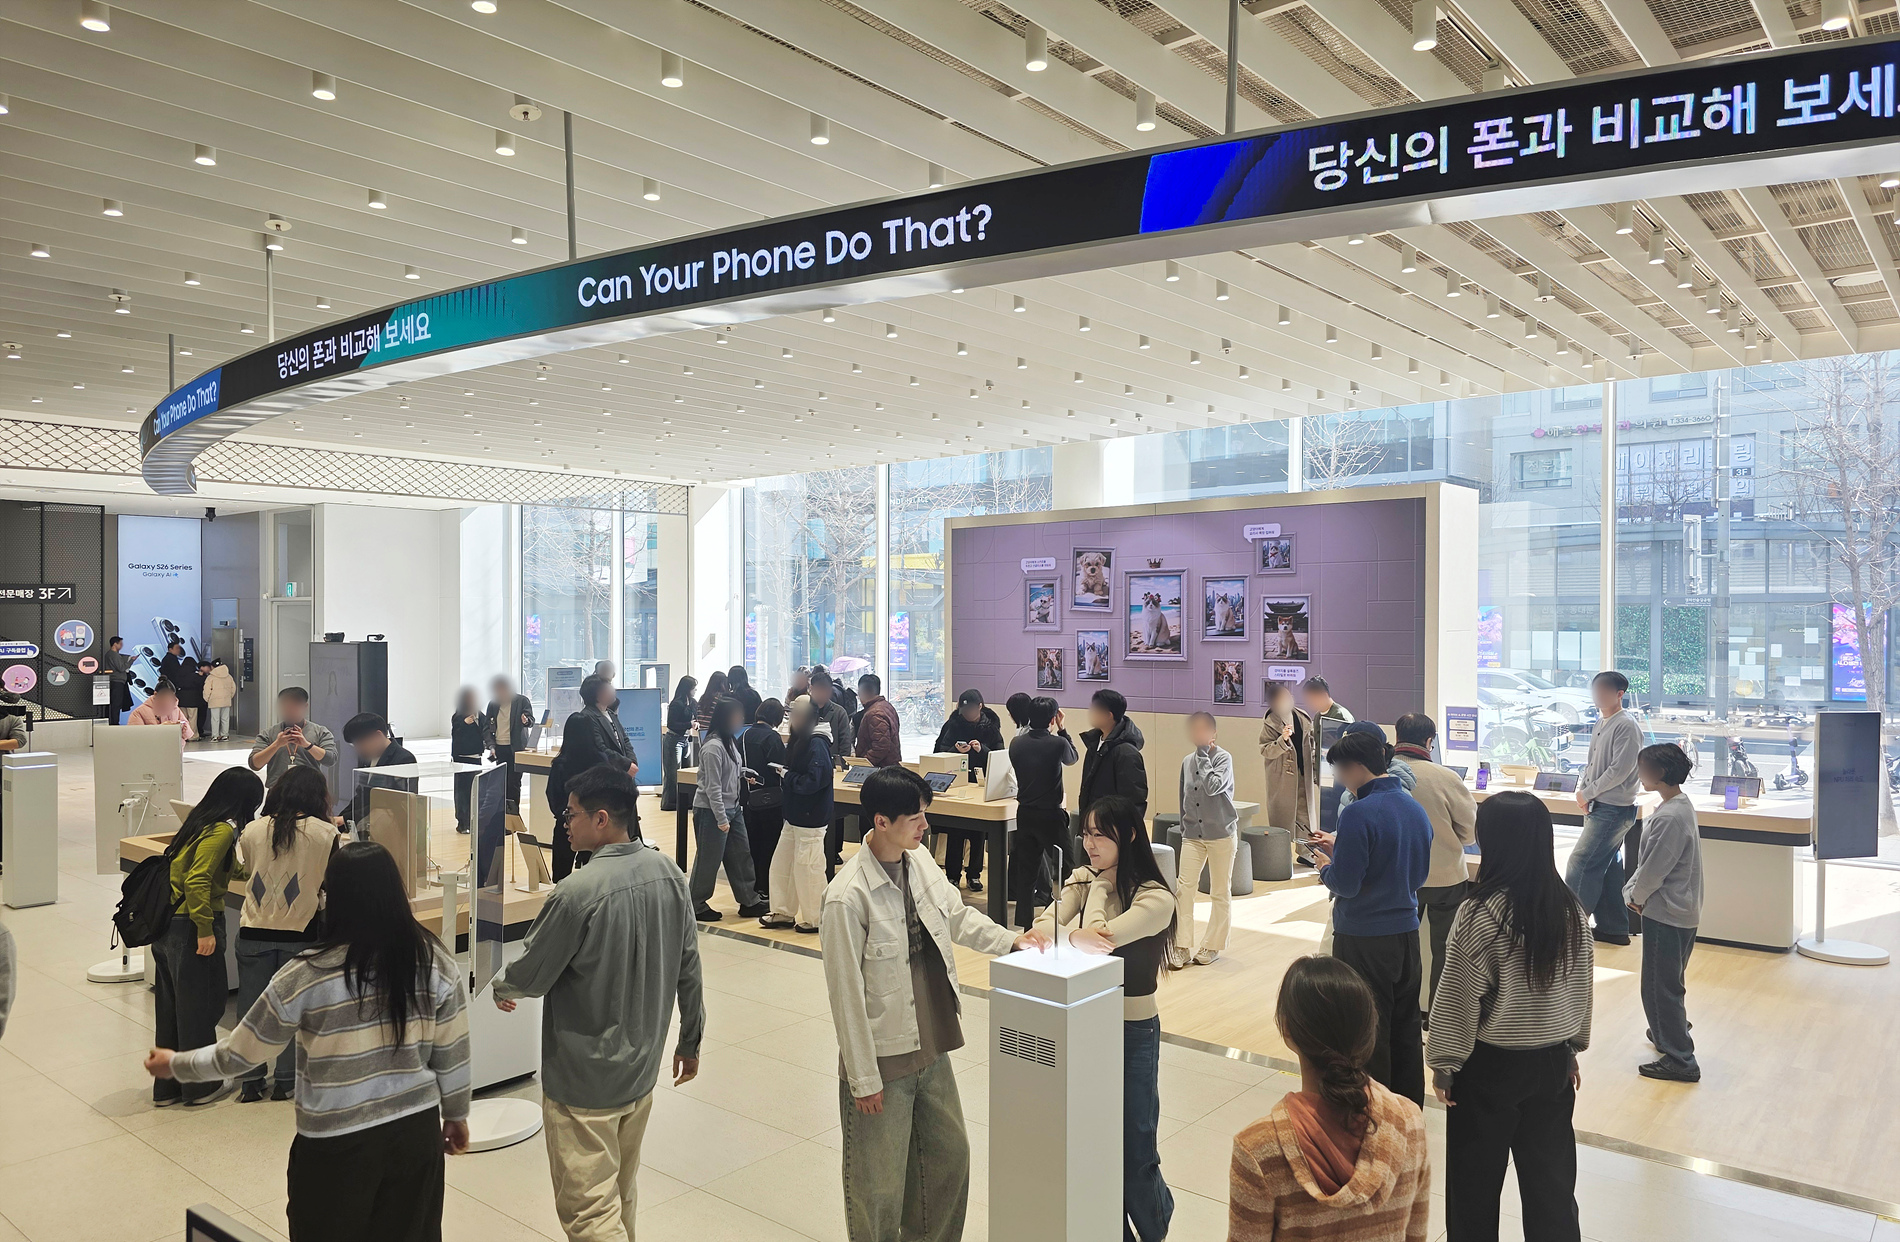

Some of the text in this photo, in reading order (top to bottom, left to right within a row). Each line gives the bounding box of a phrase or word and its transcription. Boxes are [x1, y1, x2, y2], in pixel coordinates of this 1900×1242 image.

[1308, 63, 1900, 192] 당신의 폰과 비교해 보세
[577, 203, 993, 308] Can Your Phone Do That?
[277, 312, 432, 379] 당신의 폰과 비교해 보세요
[153, 381, 217, 436] Can Your Phone Do That?
[1735, 468, 1748, 476] 3F
[38, 587, 56, 600] 3F
[127, 562, 156, 571] Galaxy
[170, 563, 193, 571] Series
